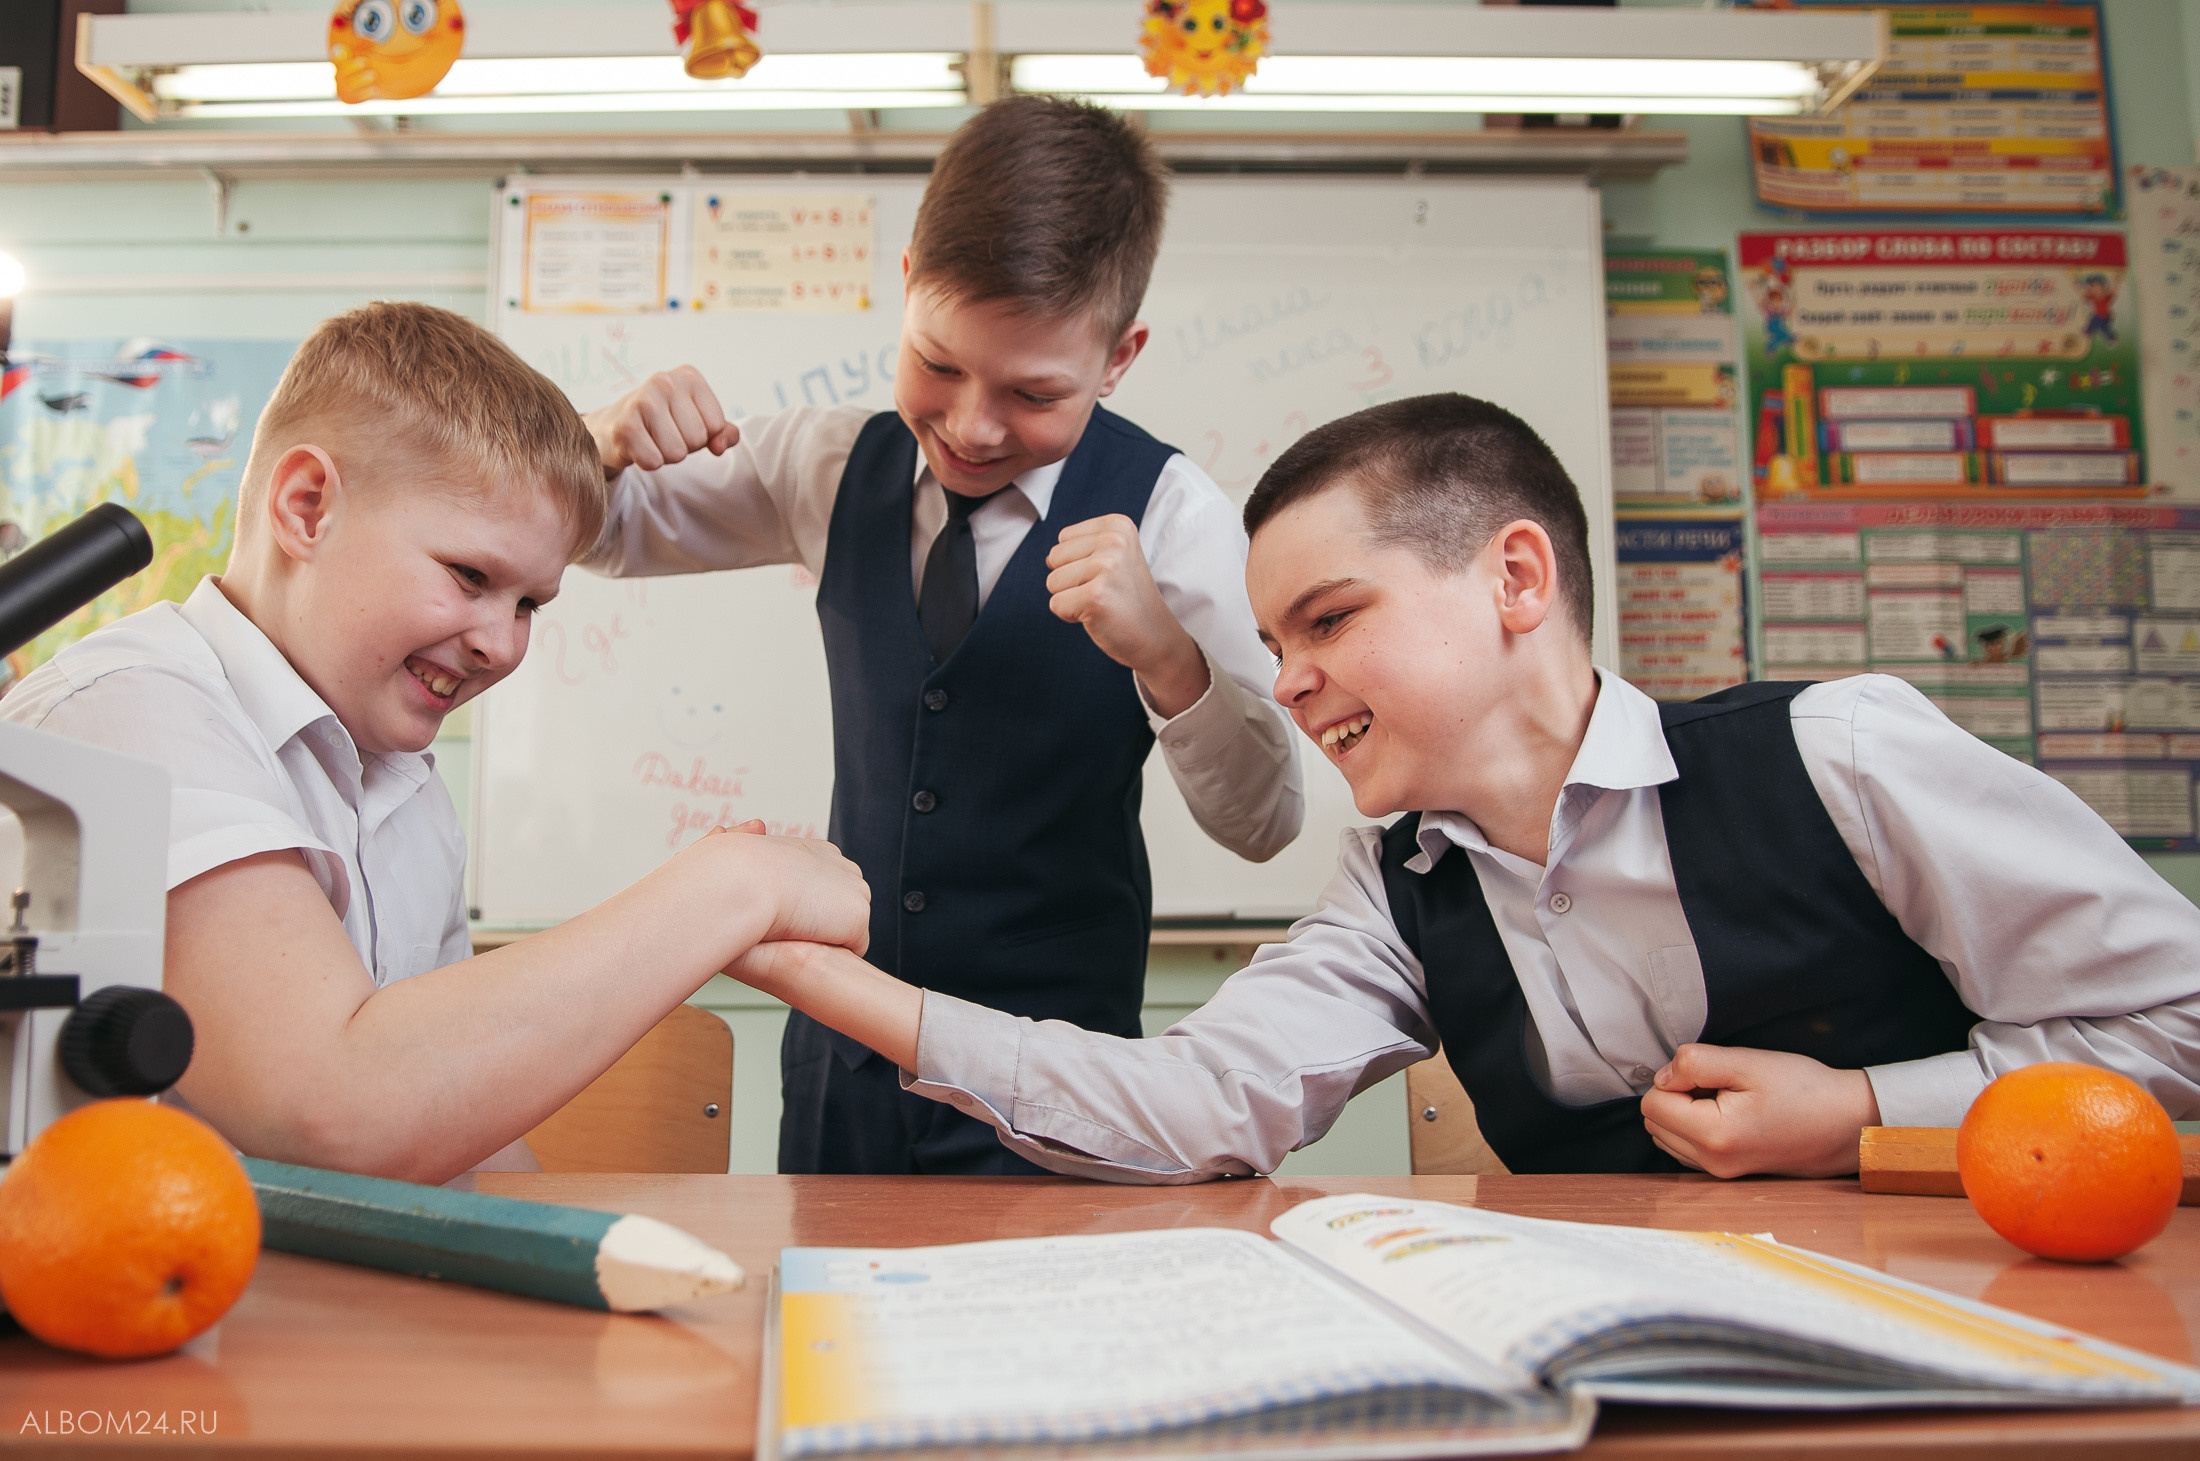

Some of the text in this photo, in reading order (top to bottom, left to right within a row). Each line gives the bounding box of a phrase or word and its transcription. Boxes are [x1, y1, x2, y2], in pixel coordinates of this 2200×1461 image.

[1774, 237, 2099, 260] РАЗБОР СЛОВА ПО СОСТАВУ
[1616, 528, 1672, 549] АСТИ
[632, 750, 752, 798] Давай
